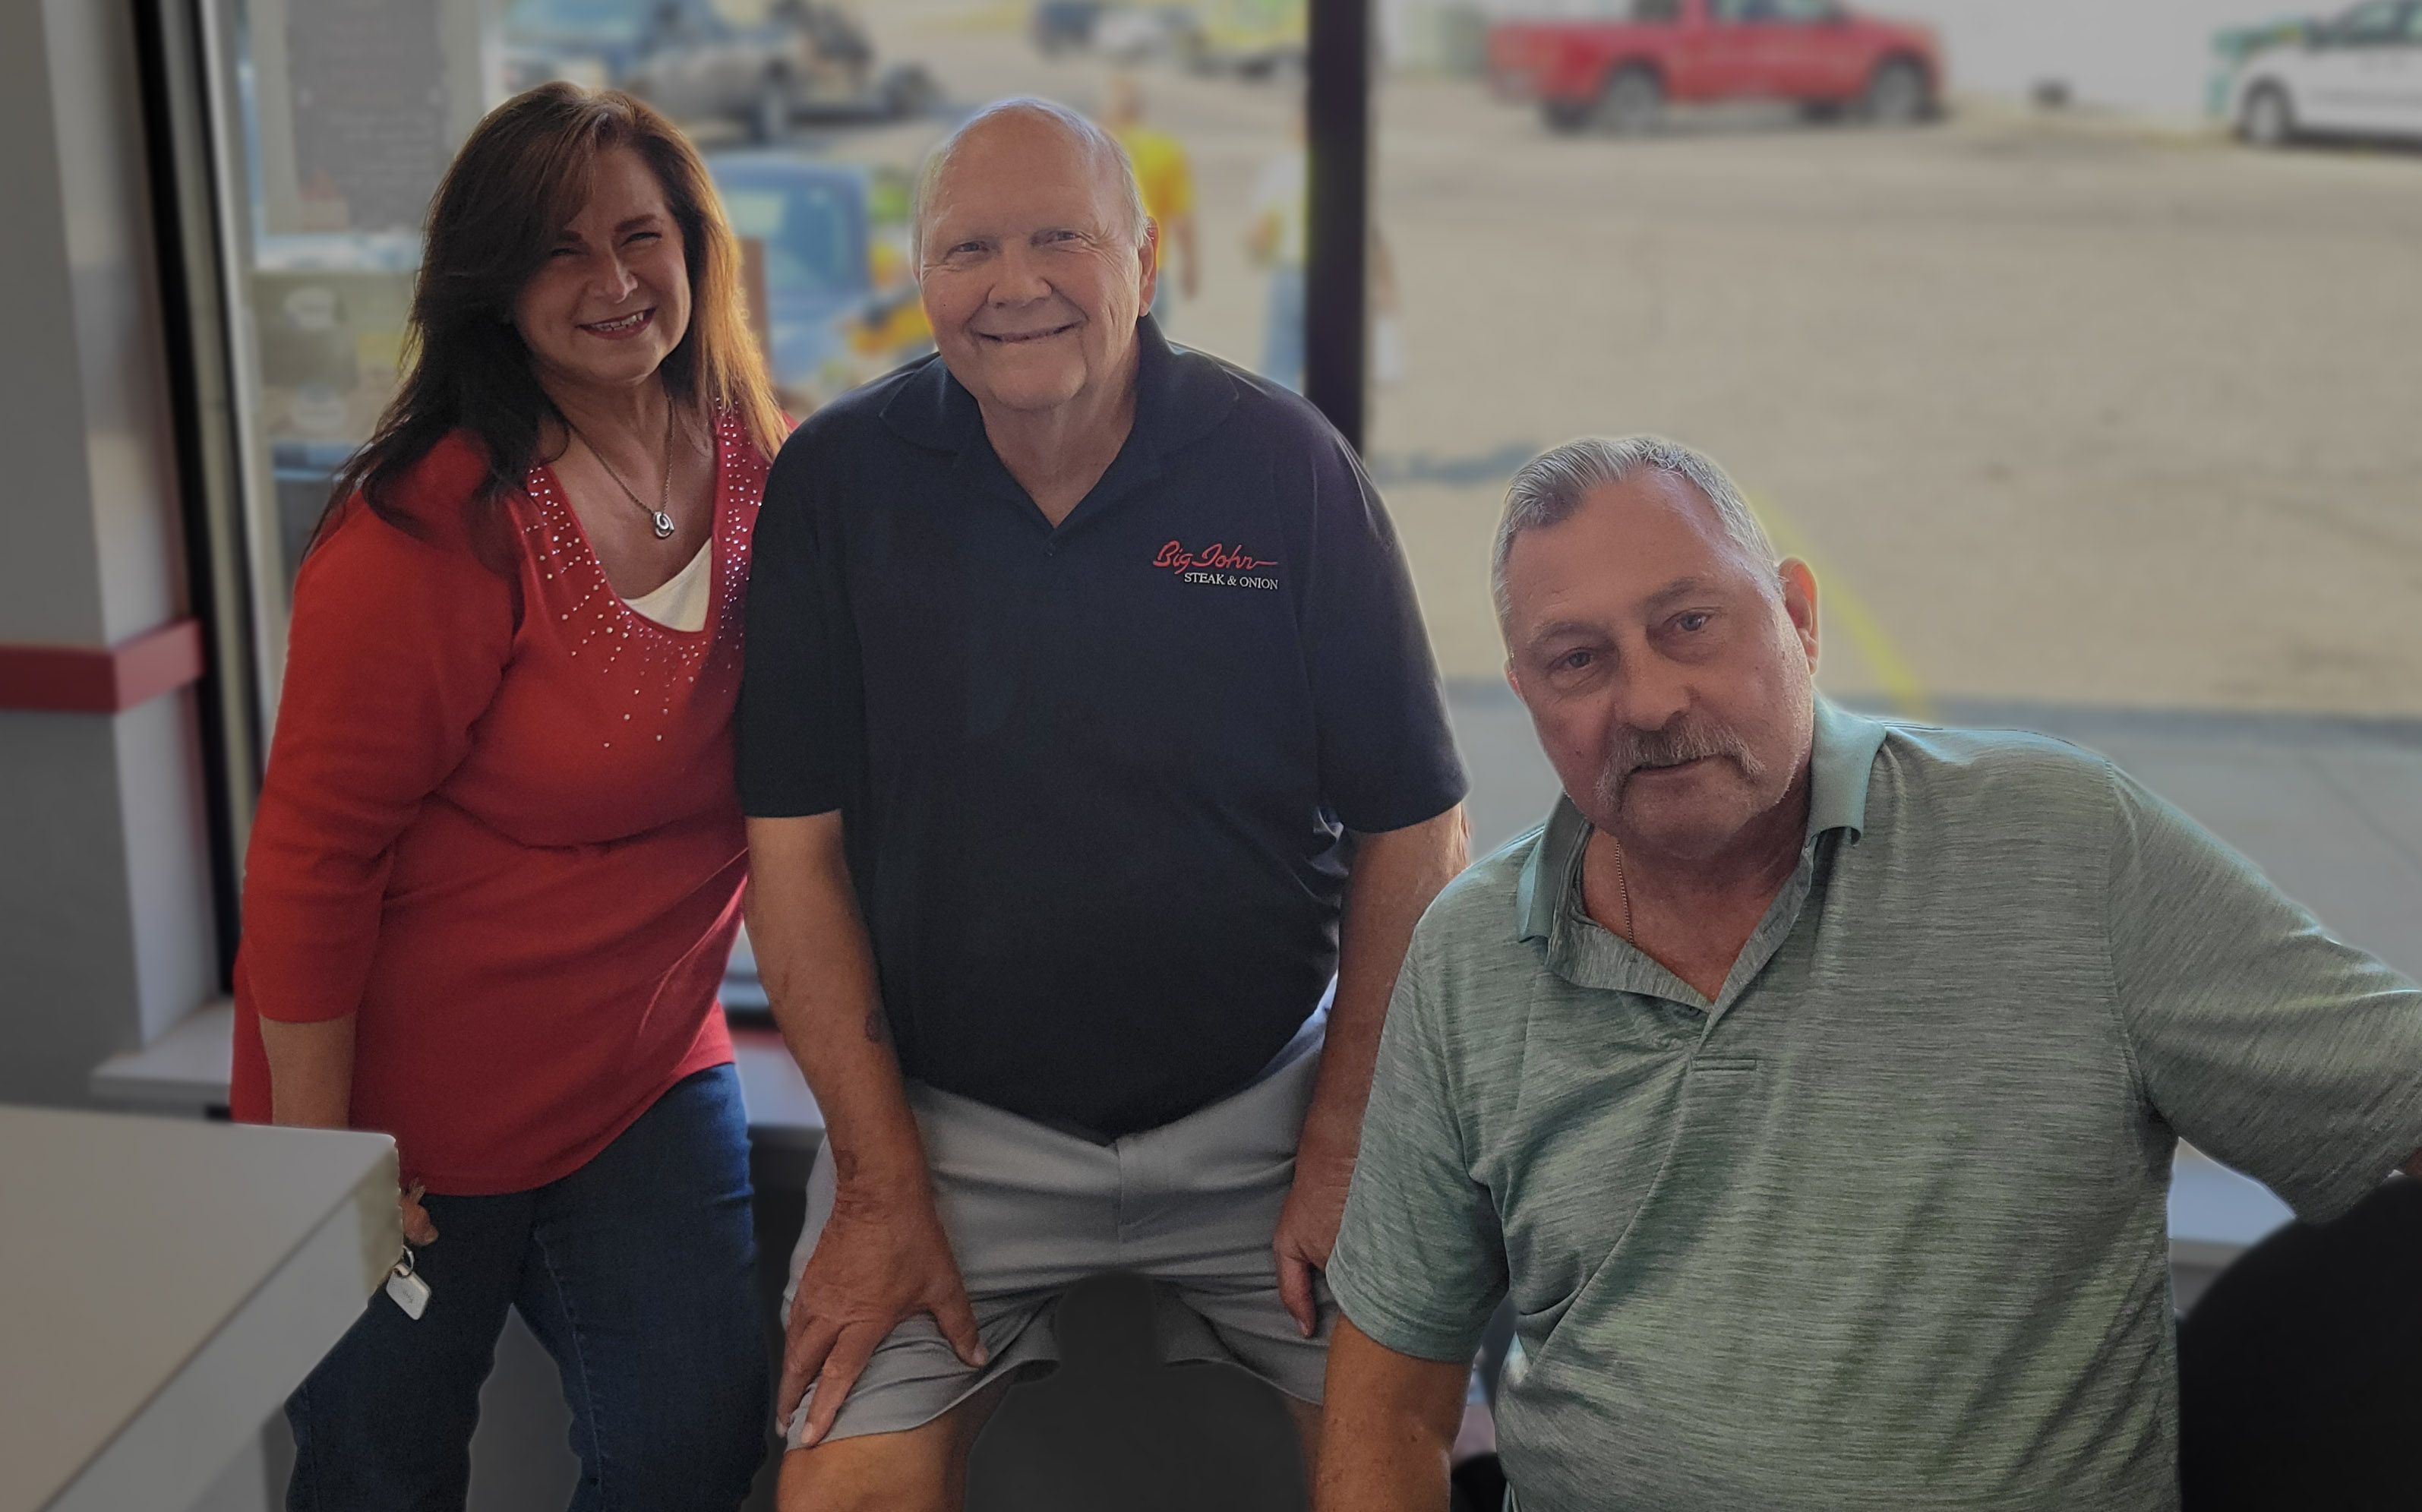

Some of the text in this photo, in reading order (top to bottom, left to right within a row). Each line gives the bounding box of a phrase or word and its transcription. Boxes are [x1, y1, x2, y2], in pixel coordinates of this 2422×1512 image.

[1153, 540, 1278, 575] Big John
[1184, 572, 1278, 590] STEAK & ONION
